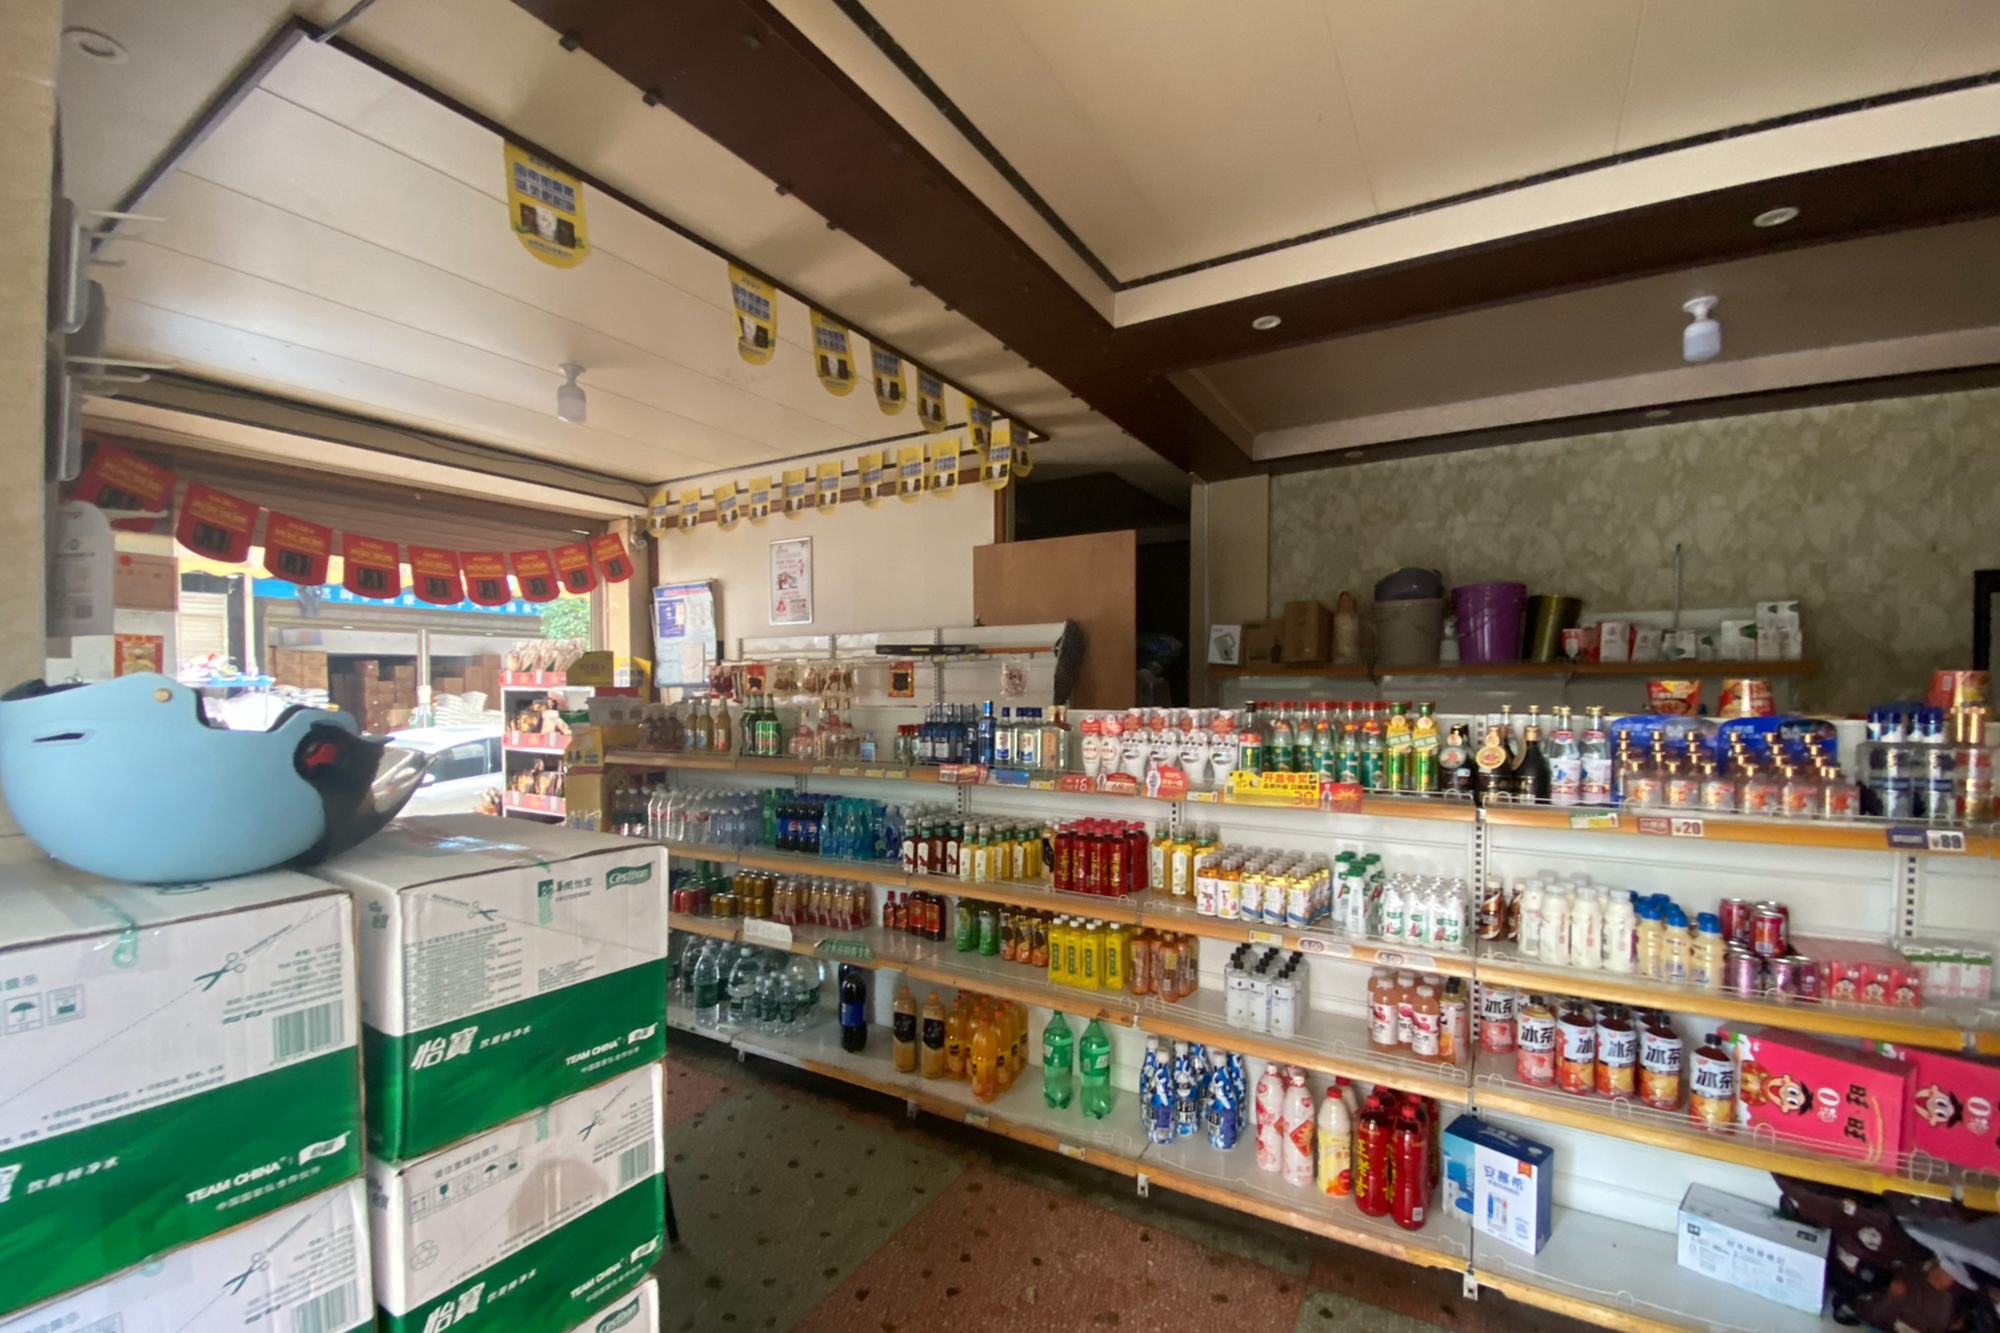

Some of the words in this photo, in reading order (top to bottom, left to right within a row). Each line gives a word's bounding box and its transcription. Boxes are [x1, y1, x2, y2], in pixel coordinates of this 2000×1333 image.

[1521, 1026, 1555, 1045] 冰茶
[565, 1049, 591, 1066] TEAM
[591, 1039, 619, 1056] CHINA
[1646, 1046, 1682, 1066] 冰茶
[1696, 1068, 1734, 1090] 冰茶
[185, 1178, 232, 1204] TEAM
[233, 1160, 282, 1187] CHINA
[570, 1281, 595, 1299] TEAM
[596, 1261, 623, 1283] CHINA
